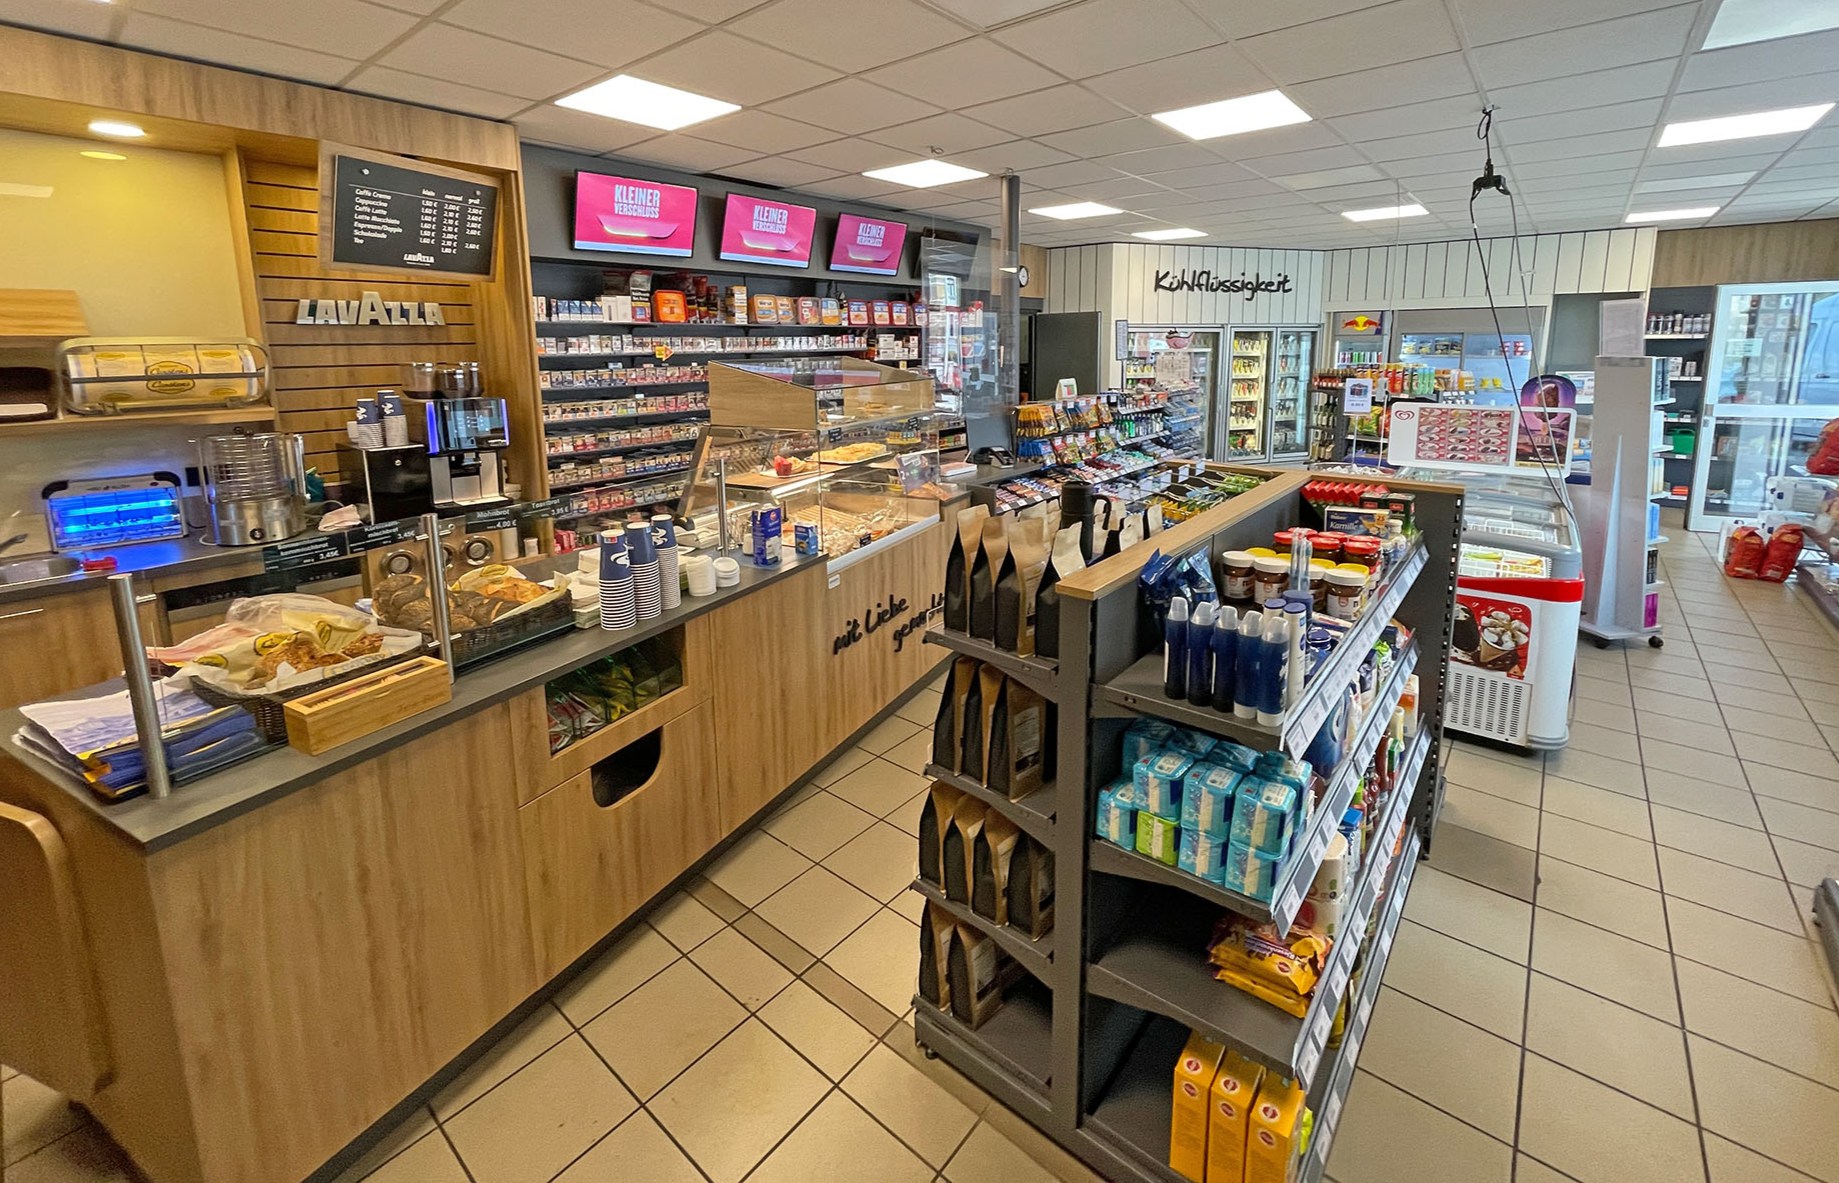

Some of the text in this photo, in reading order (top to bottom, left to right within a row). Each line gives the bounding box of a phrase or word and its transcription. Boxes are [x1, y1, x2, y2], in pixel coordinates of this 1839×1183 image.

[355, 196, 388, 207] Cappuccino
[614, 184, 660, 207] KLEINER
[614, 202, 660, 218] VERSCHLUSS
[754, 204, 788, 224] KLEINER
[371, 216, 400, 224] Macchiato
[752, 220, 787, 234] VERSCHLUSS
[354, 229, 388, 238] Schokolade
[858, 222, 886, 239] KLEINER
[404, 252, 434, 263] LAVAZZA
[1154, 268, 1292, 302] Kühlflüssigkeit
[297, 291, 446, 326] LAVAZZA
[476, 509, 510, 518] Mohnbrot
[1329, 520, 1358, 530] Kamille
[833, 594, 910, 655] mit Liebe
